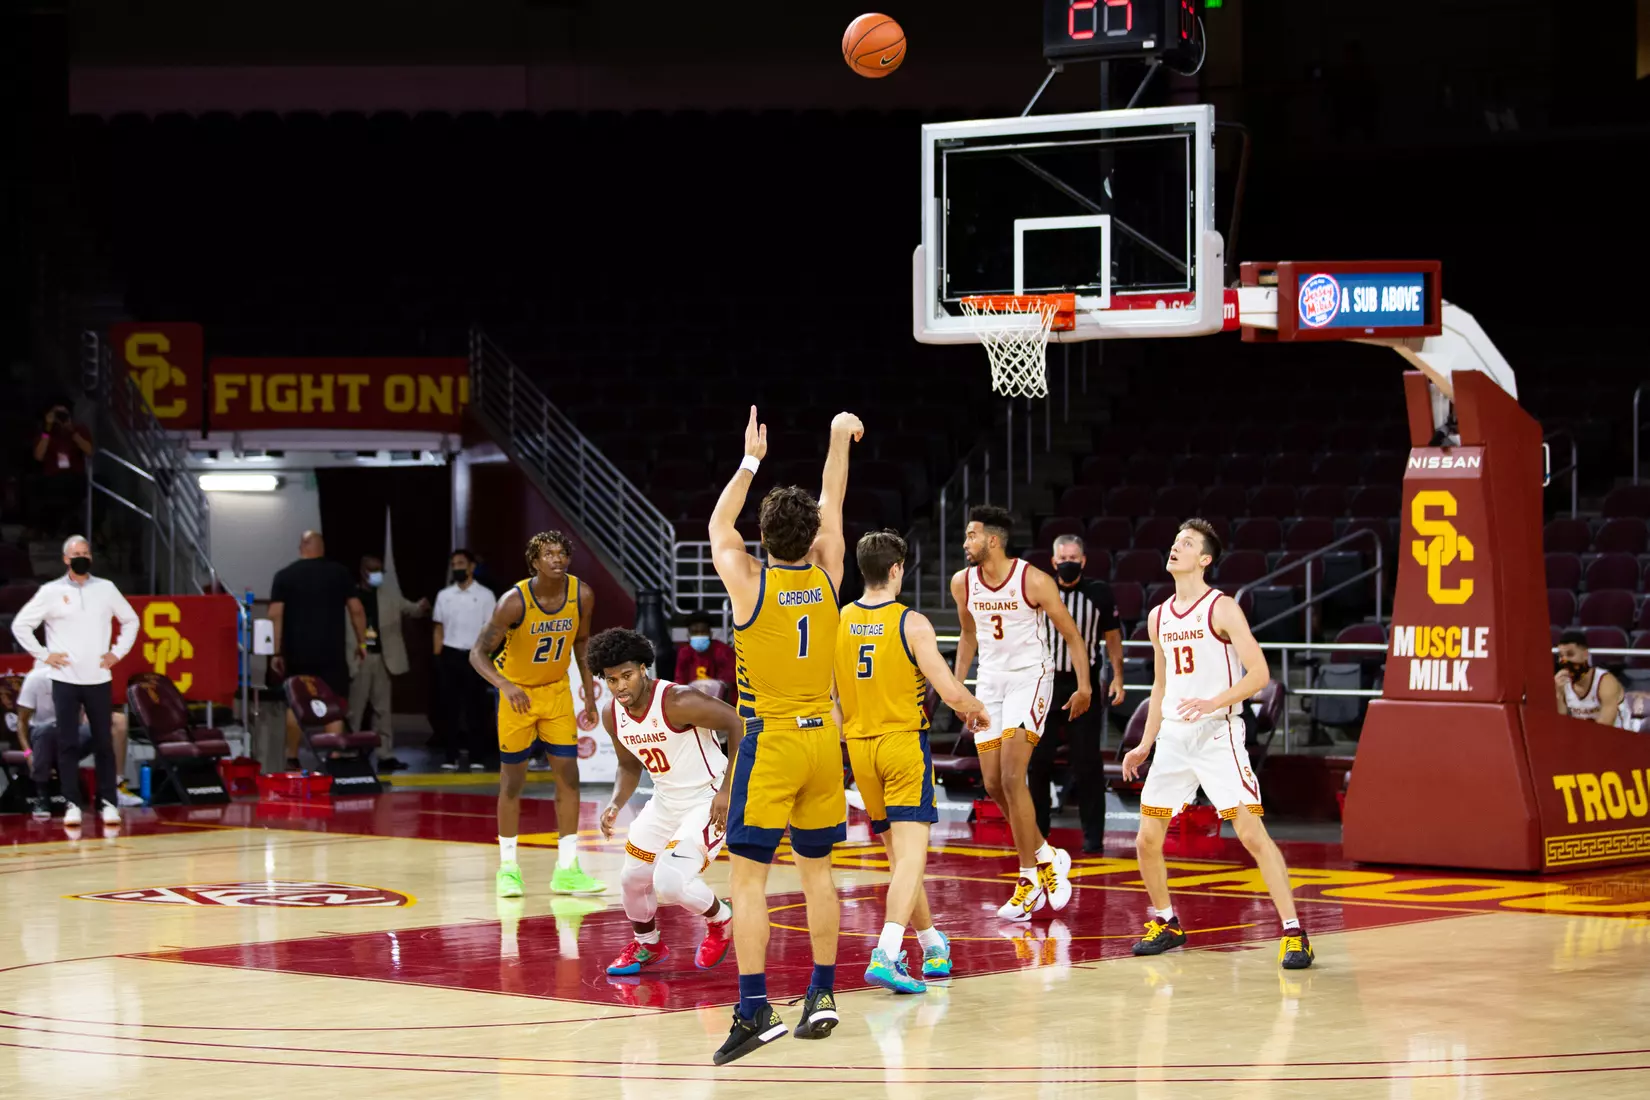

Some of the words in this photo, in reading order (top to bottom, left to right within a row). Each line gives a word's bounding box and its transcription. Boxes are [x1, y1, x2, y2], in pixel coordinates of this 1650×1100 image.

[1341, 287, 1350, 312] A
[1354, 286, 1378, 312] SUB
[1381, 285, 1421, 312] ABOVE
[214, 374, 370, 413] FIGHT
[1409, 456, 1481, 469] NISSAN
[778, 587, 823, 606] CARBONE
[973, 602, 1019, 611] TROJANS
[530, 618, 573, 635] LANCERS
[797, 614, 809, 659] 1
[990, 614, 1004, 640] 3
[1162, 629, 1204, 643] TROJANS
[532, 636, 566, 664] 21
[1393, 625, 1490, 659] MUSCLE
[857, 644, 876, 680] 5
[1173, 645, 1195, 675] 13
[1409, 659, 1472, 692] MILK
[623, 731, 668, 745] TROJANS
[638, 747, 672, 775] 20
[1552, 768, 1650, 824] TROJ
